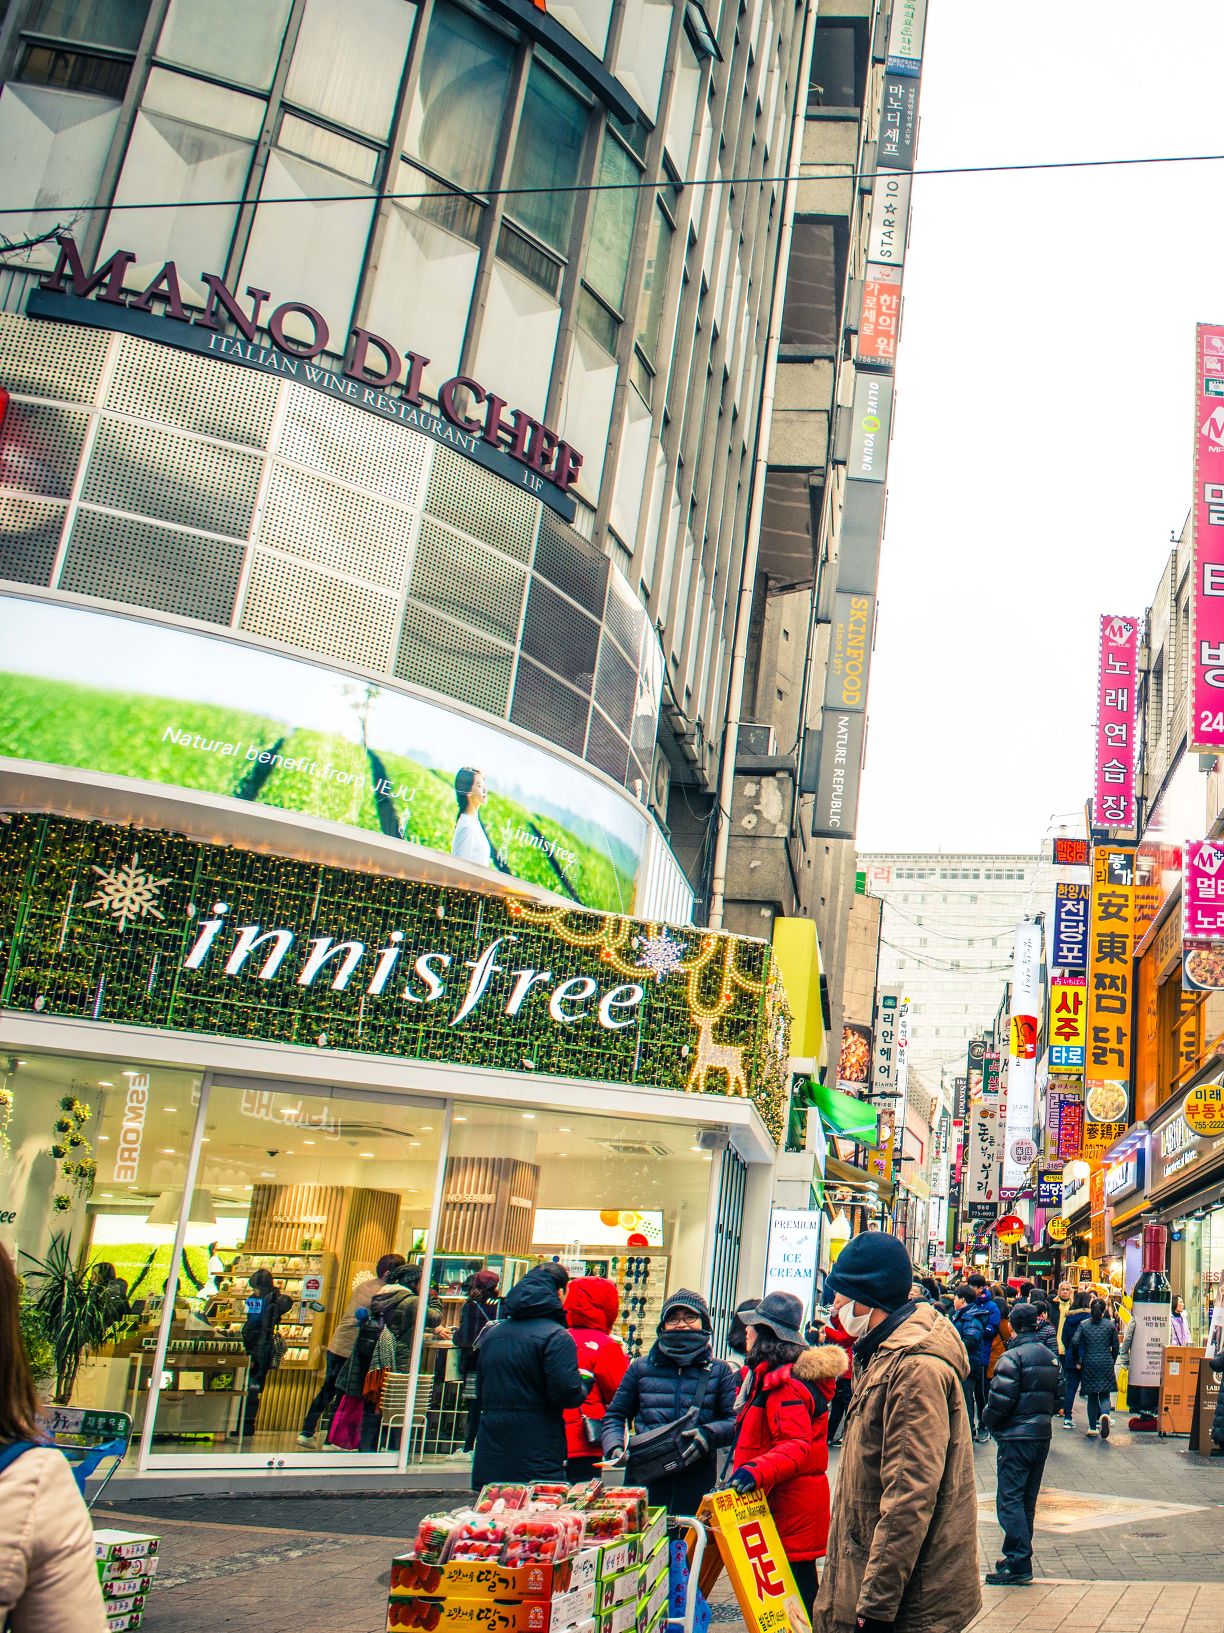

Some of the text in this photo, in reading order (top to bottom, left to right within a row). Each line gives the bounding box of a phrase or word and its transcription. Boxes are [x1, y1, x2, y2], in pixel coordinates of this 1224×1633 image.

[880, 217, 896, 258] STAR
[861, 281, 880, 336] 가로세로
[875, 293, 900, 358] 한의원
[39, 236, 585, 493] MANO DI CHEF
[207, 332, 480, 455] ITALIAN WINE RESTAURANT
[862, 381, 880, 472] OLIVE YOUNG
[522, 467, 545, 493] 11F
[832, 622, 845, 676] since 1957
[842, 596, 869, 706] SKINFOOD
[1101, 652, 1131, 821] 노래연습장
[161, 725, 417, 804] Natural benefit from JEJU
[829, 715, 850, 828] NATURE REPUBLIC
[514, 826, 579, 868] innisfree
[1107, 853, 1135, 886] 봉가
[1057, 884, 1090, 900] 한양사
[1057, 900, 1087, 964] 전당포
[183, 902, 645, 1030] innisfree
[1054, 991, 1084, 1042] 사주
[878, 1012, 895, 1079] 리안헤어
[1051, 1047, 1083, 1065] 타로
[1195, 1088, 1222, 1102] 미래
[1194, 1120, 1224, 1130] 755-2222
[447, 1193, 493, 1204] NO SEBUM
[1039, 1183, 1063, 1196] 전당
[272, 1215, 292, 1223] PACK
[773, 1219, 818, 1230] PREMIUM
[769, 1267, 813, 1279] CREAM
[782, 1253, 802, 1264] ICE
[1201, 1271, 1222, 1282] BES
[734, 1487, 764, 1508] HELLO
[734, 1507, 748, 1521] Foot
[738, 1520, 786, 1604] 足
[476, 1570, 517, 1594] 딸기
[476, 1608, 517, 1633] 딸기
